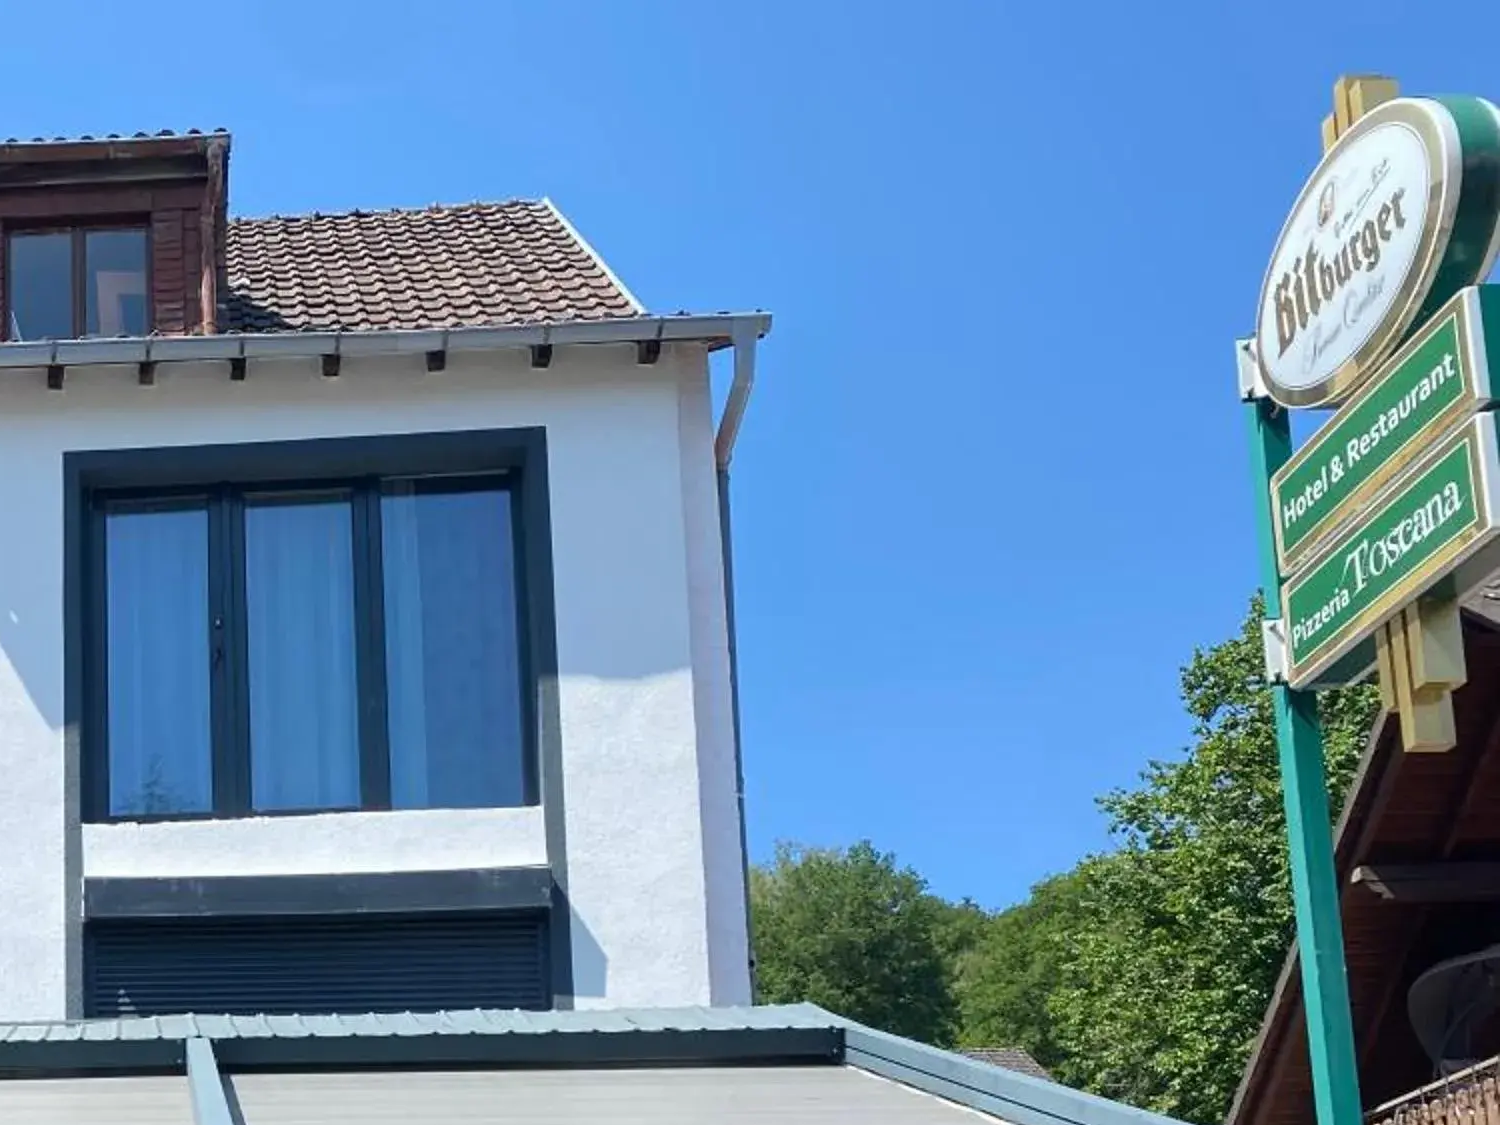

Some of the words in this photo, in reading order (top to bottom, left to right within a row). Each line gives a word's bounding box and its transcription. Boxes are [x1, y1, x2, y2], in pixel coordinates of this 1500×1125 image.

[1274, 187, 1407, 358] Bitburger
[1283, 466, 1330, 530] Hotel
[1330, 456, 1346, 486] &
[1347, 352, 1457, 470] Restaurant
[1291, 586, 1350, 649] Pizzeria
[1339, 480, 1466, 600] Toscana
